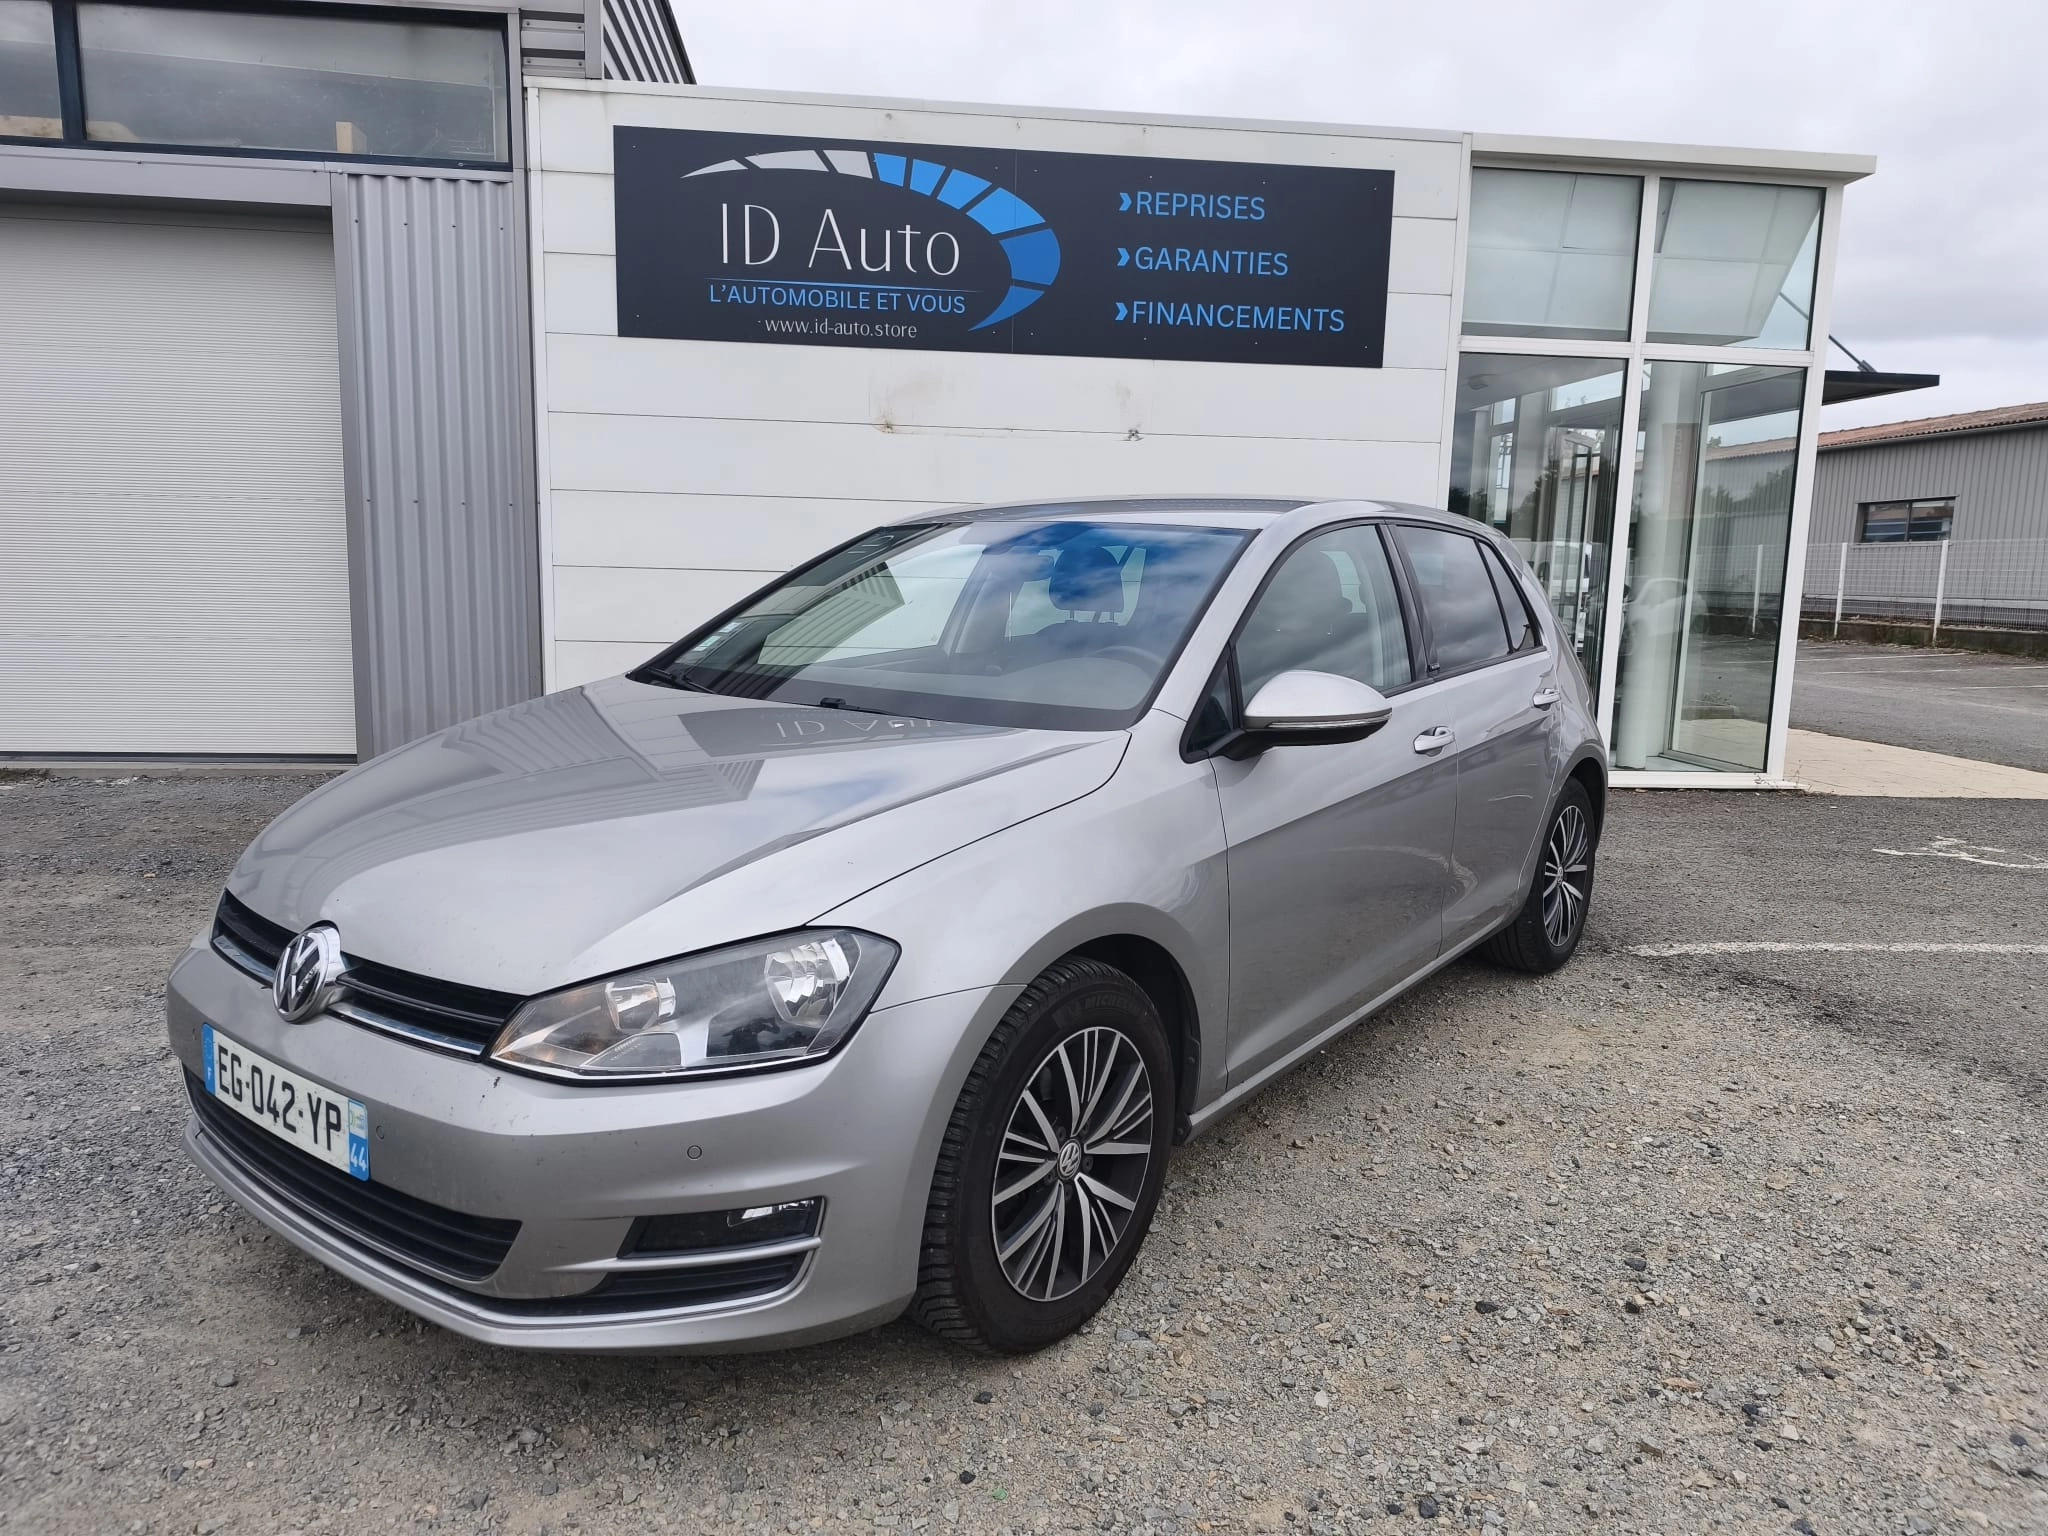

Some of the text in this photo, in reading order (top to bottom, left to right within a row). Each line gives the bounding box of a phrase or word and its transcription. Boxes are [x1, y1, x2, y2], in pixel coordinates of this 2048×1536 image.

[1135, 191, 1266, 221] REPRISES
[721, 203, 961, 276] ID Auto
[1134, 246, 1289, 277] GARANTIES
[877, 292, 901, 312] ET
[907, 293, 967, 315] VOUS
[1132, 301, 1346, 333] FINANCEMENTS
[765, 319, 918, 340] www.id-auto.store
[217, 1041, 342, 1151] EG-042-YP
[350, 1142, 367, 1173] 44
